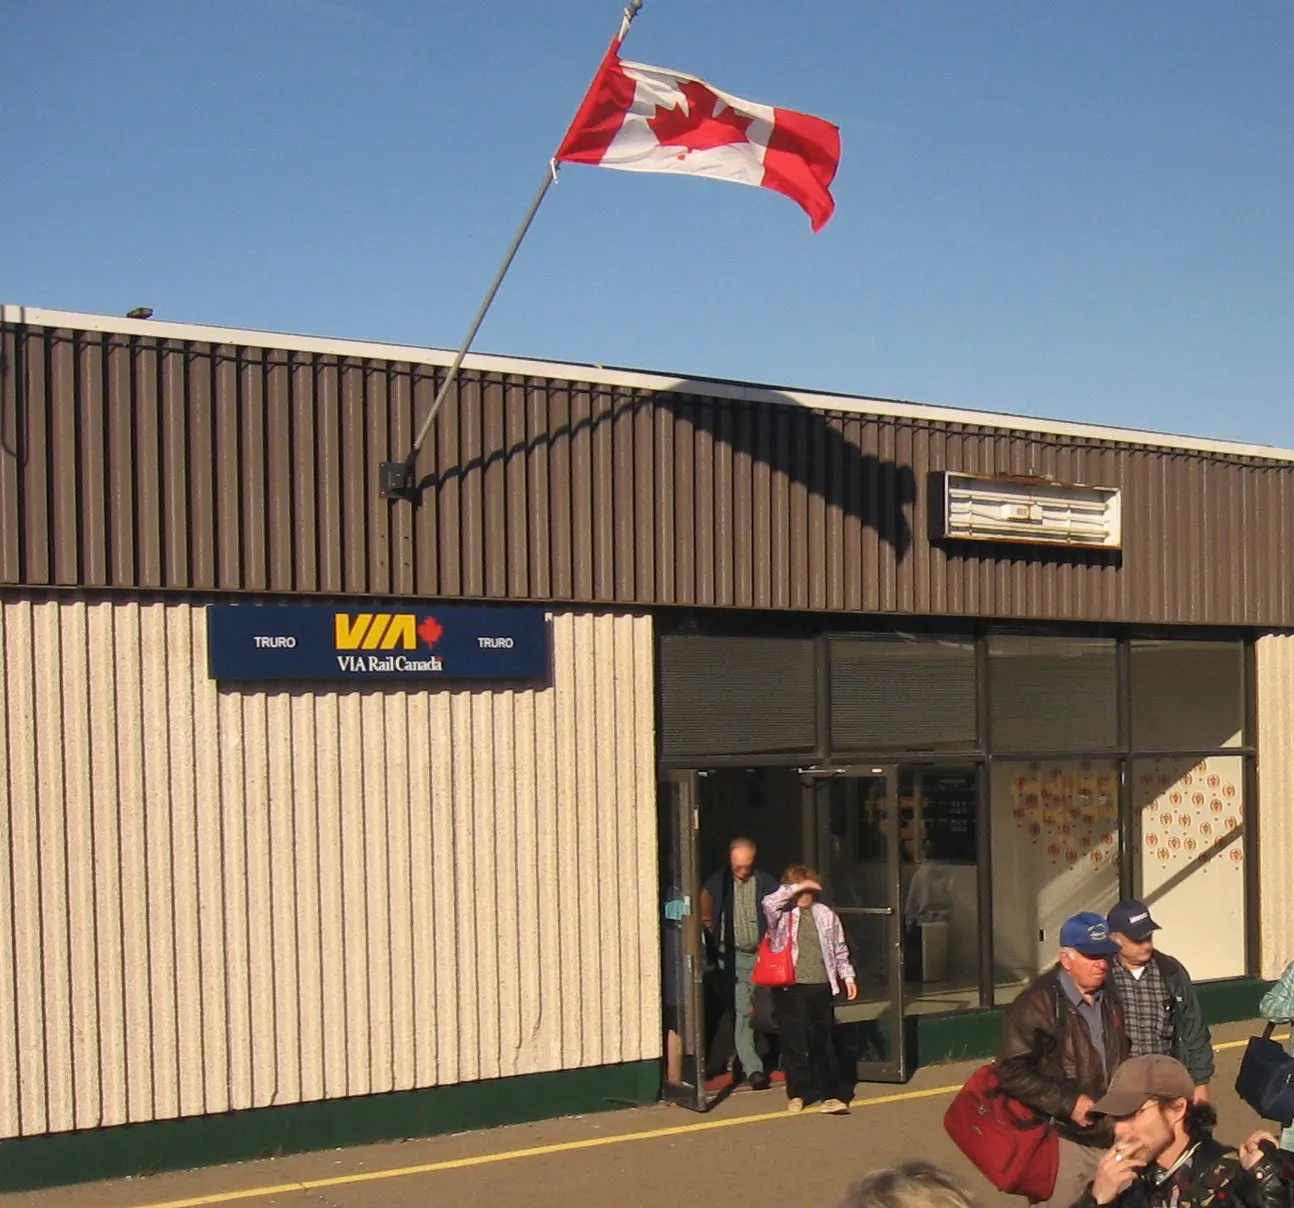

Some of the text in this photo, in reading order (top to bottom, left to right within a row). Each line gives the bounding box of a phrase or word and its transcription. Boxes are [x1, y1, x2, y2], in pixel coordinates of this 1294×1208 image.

[335, 613, 417, 650] VIA
[254, 636, 296, 648] TRURO
[477, 637, 514, 648] TRURO
[337, 656, 442, 672] VIA Rail Canada
